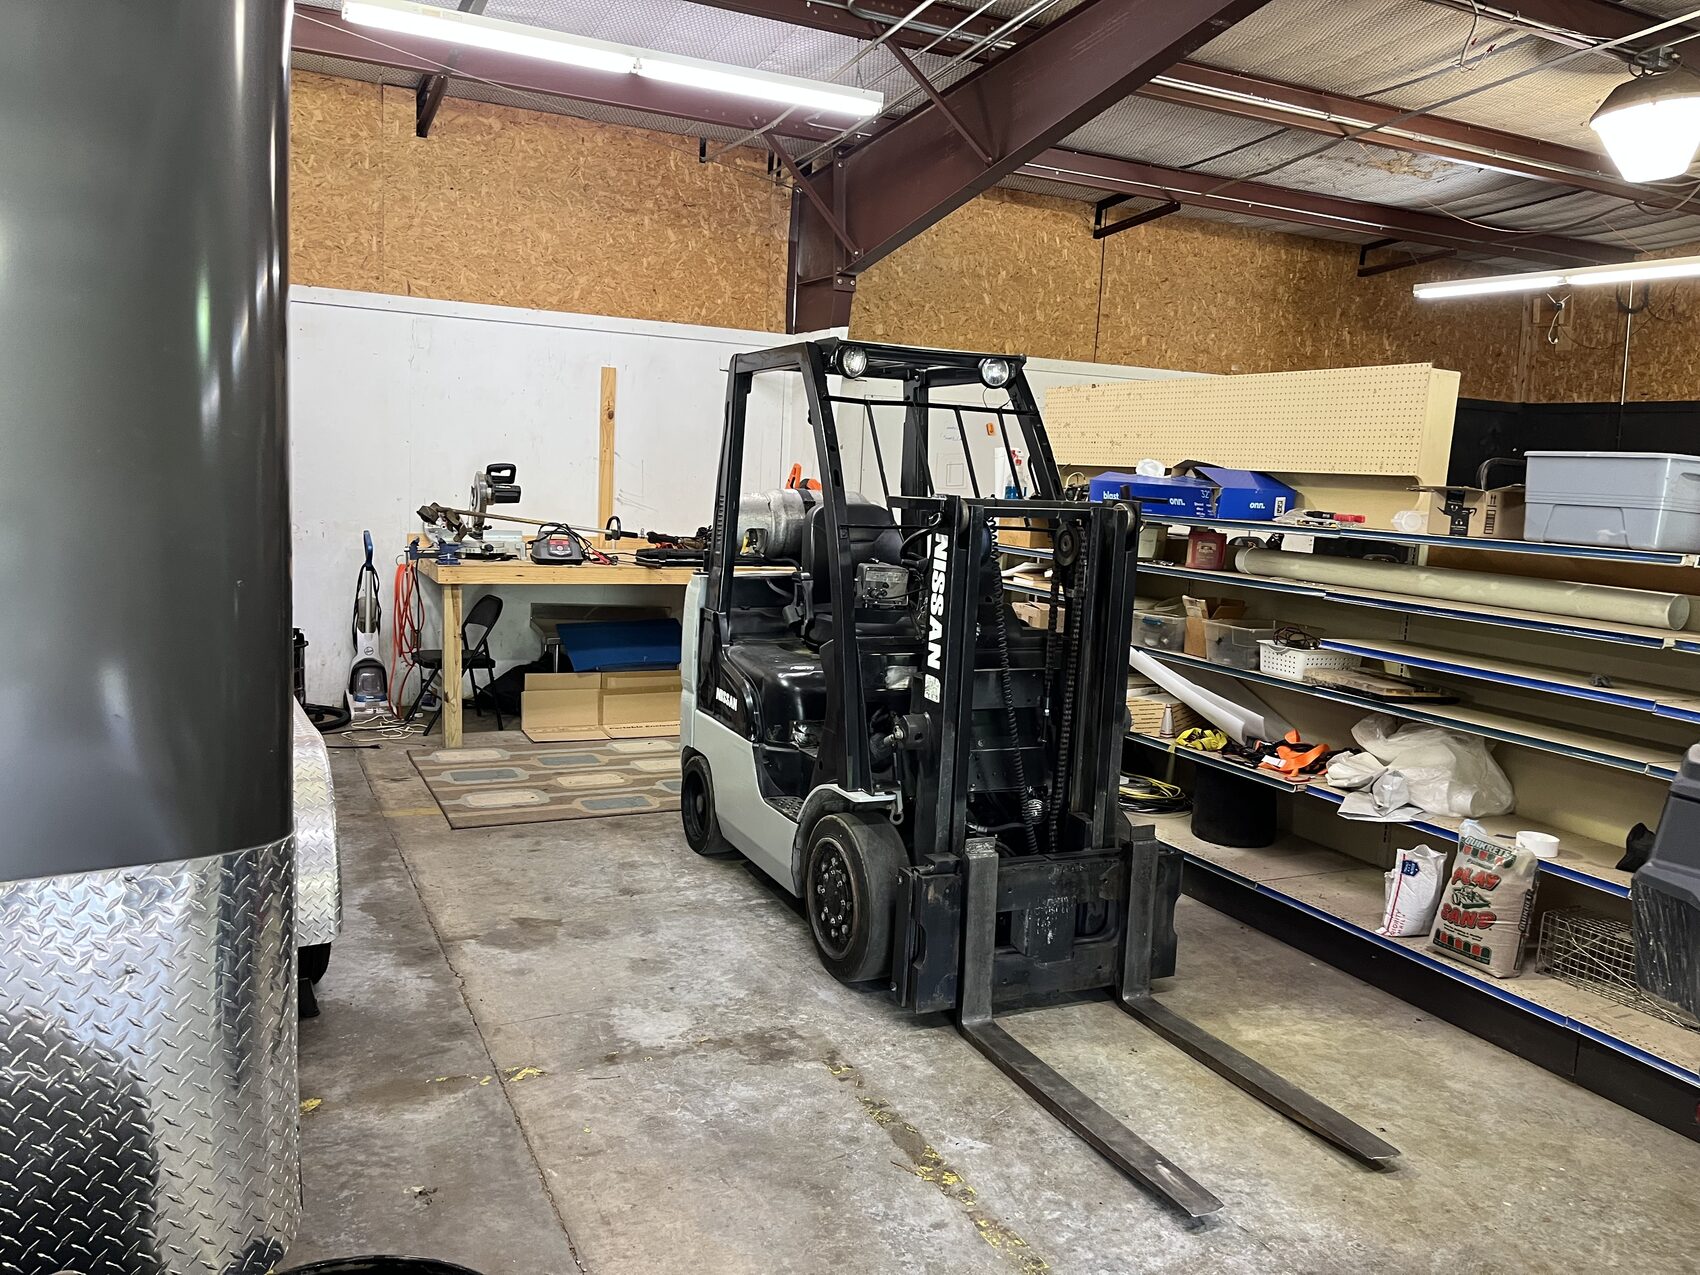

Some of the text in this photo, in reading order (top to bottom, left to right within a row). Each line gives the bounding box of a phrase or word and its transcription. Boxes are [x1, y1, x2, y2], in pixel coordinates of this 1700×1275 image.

[1103, 490, 1120, 500] blast
[927, 532, 949, 670] NISSAN
[1451, 866, 1502, 891] PLAY
[1441, 903, 1497, 929] SAND
